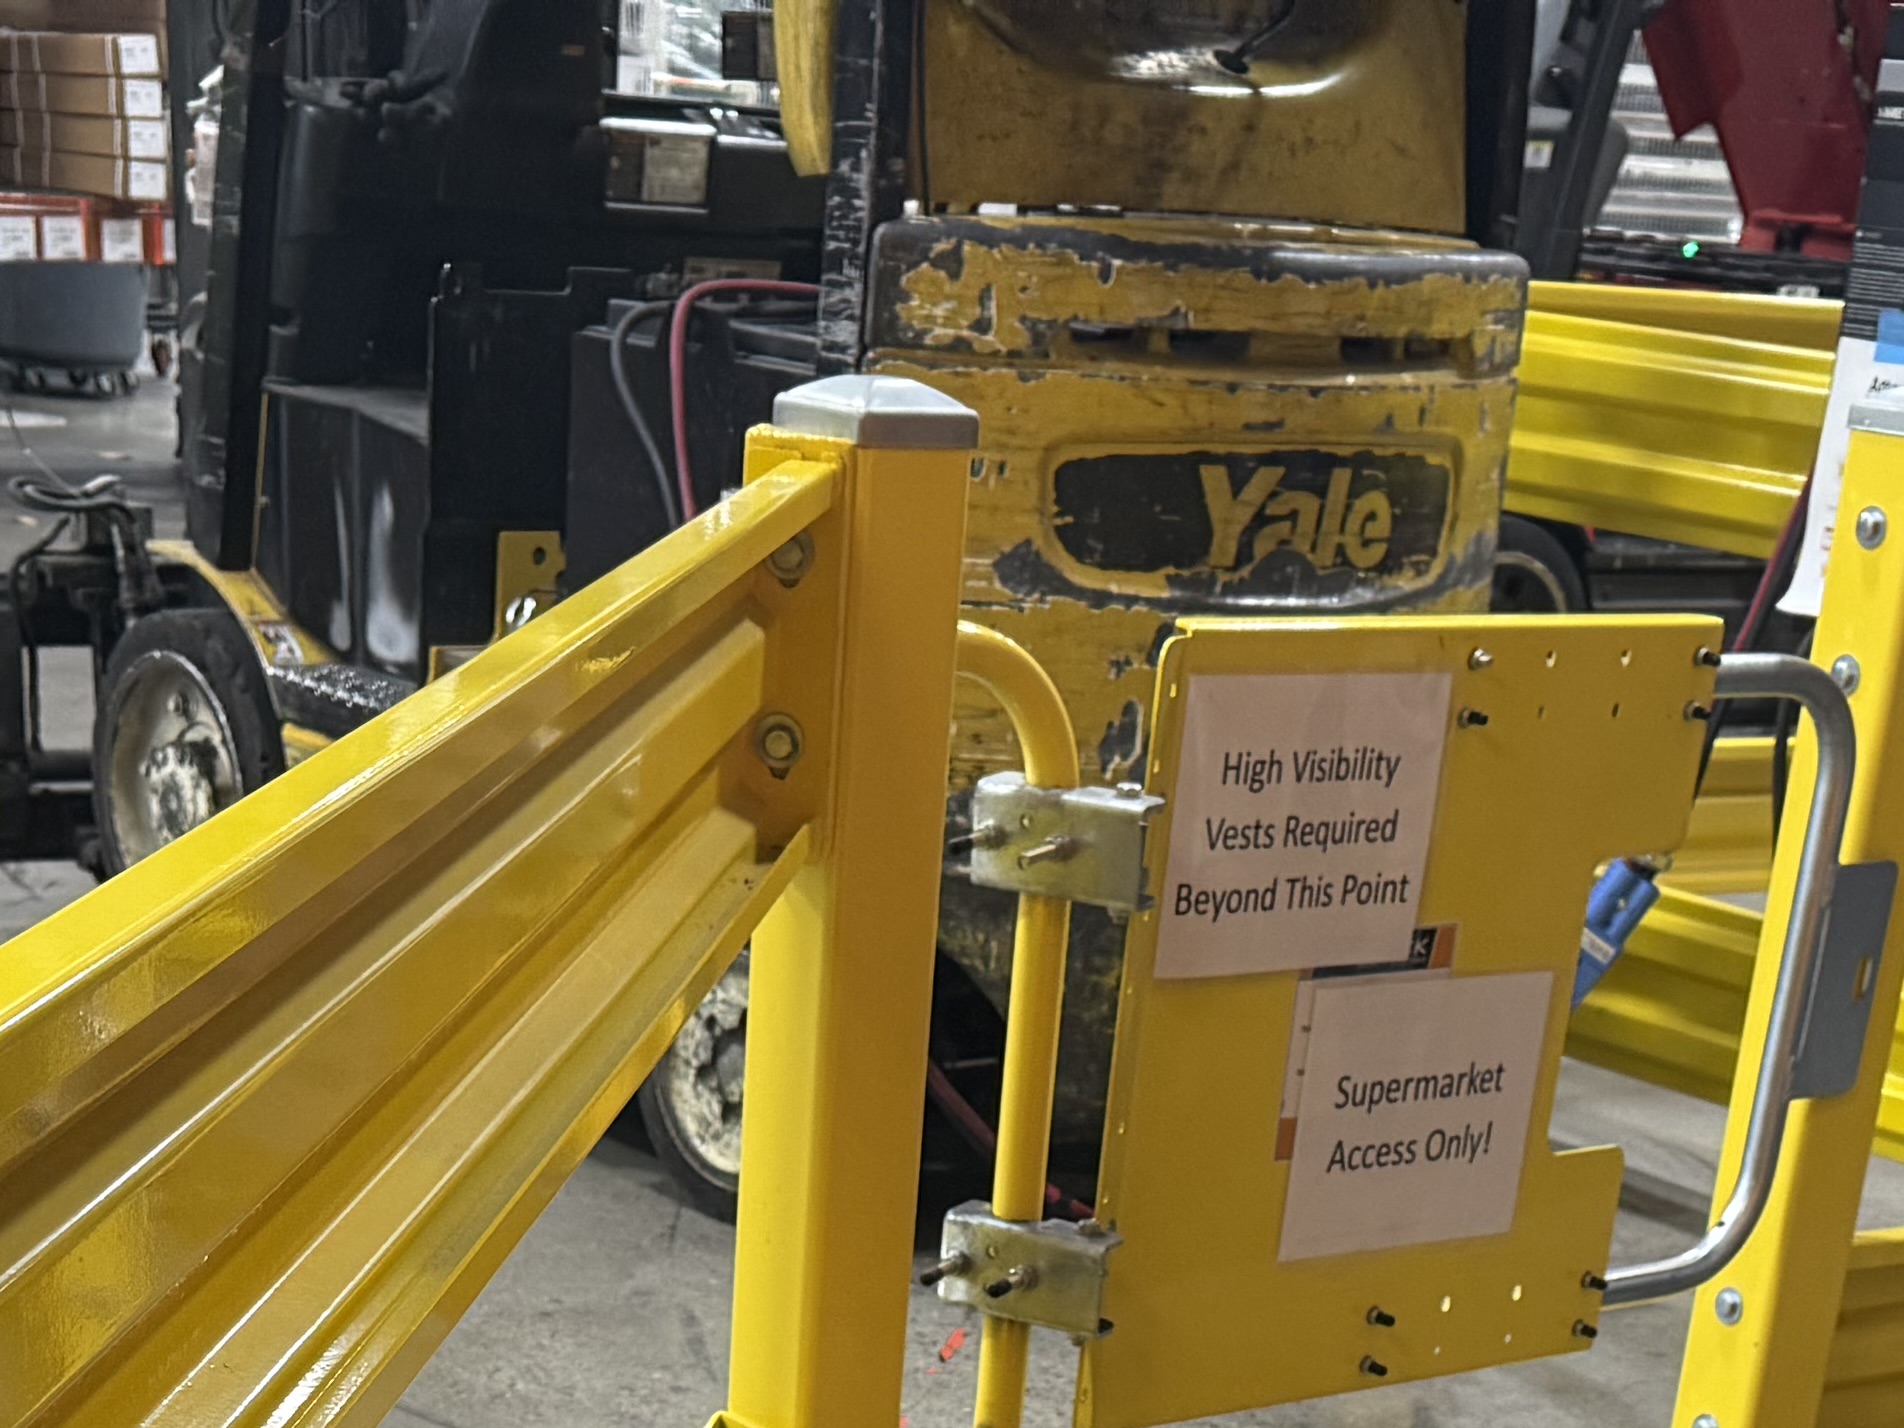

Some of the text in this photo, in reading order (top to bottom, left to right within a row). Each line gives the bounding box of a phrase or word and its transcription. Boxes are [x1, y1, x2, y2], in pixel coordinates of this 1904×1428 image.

[1199, 464, 1392, 569] Yale
[1222, 746, 1401, 793] High Visibility
[1206, 809, 1399, 853] Vests Required
[1175, 872, 1410, 923] Beyond This Point
[1334, 1062, 1506, 1115] Supermarket
[1326, 1121, 1494, 1174] Access Only!
